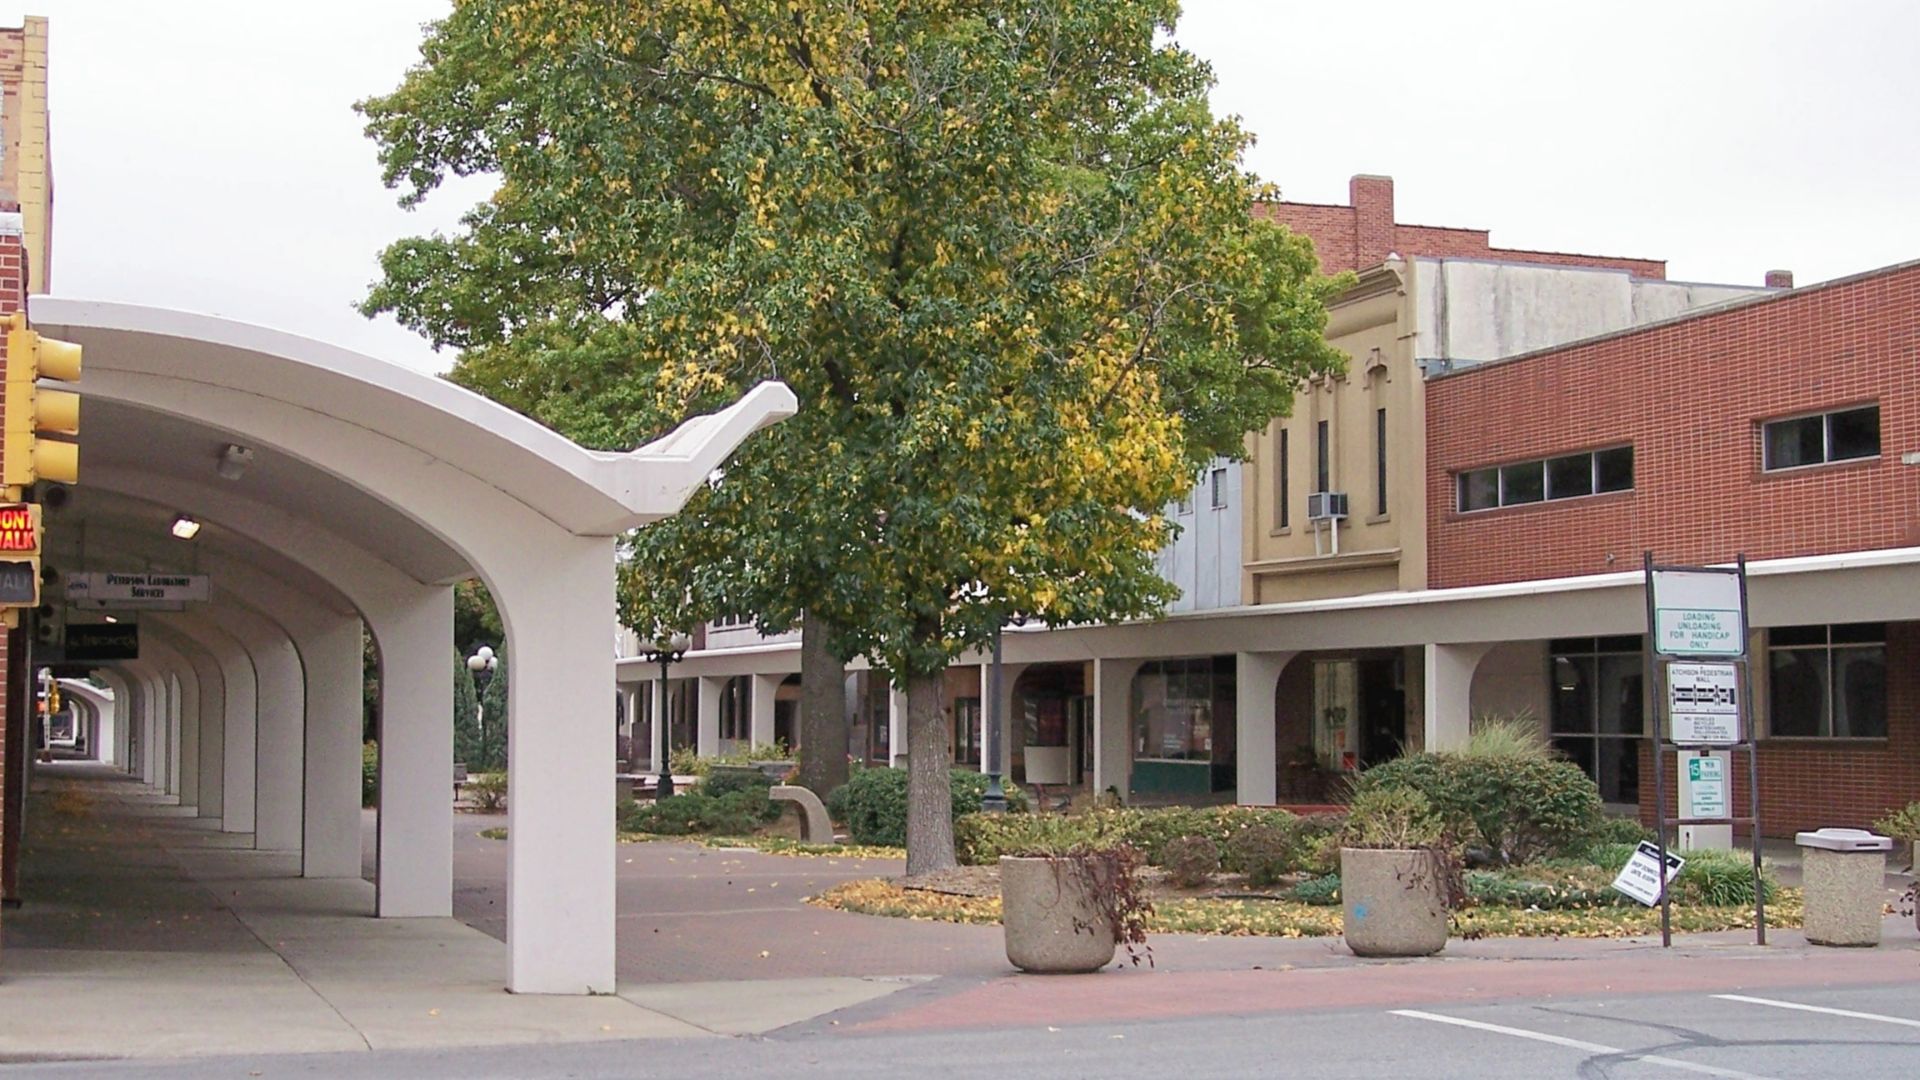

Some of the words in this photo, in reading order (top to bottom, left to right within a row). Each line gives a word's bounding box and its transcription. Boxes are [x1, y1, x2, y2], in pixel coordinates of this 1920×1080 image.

[0, 510, 32, 530] ONT
[1683, 612, 1716, 621] LOADING
[1678, 622, 1721, 630] UNLOADING
[1670, 631, 1685, 639] FOR
[1691, 631, 1730, 639] HANDICAP
[1689, 641, 1709, 649] ONLY
